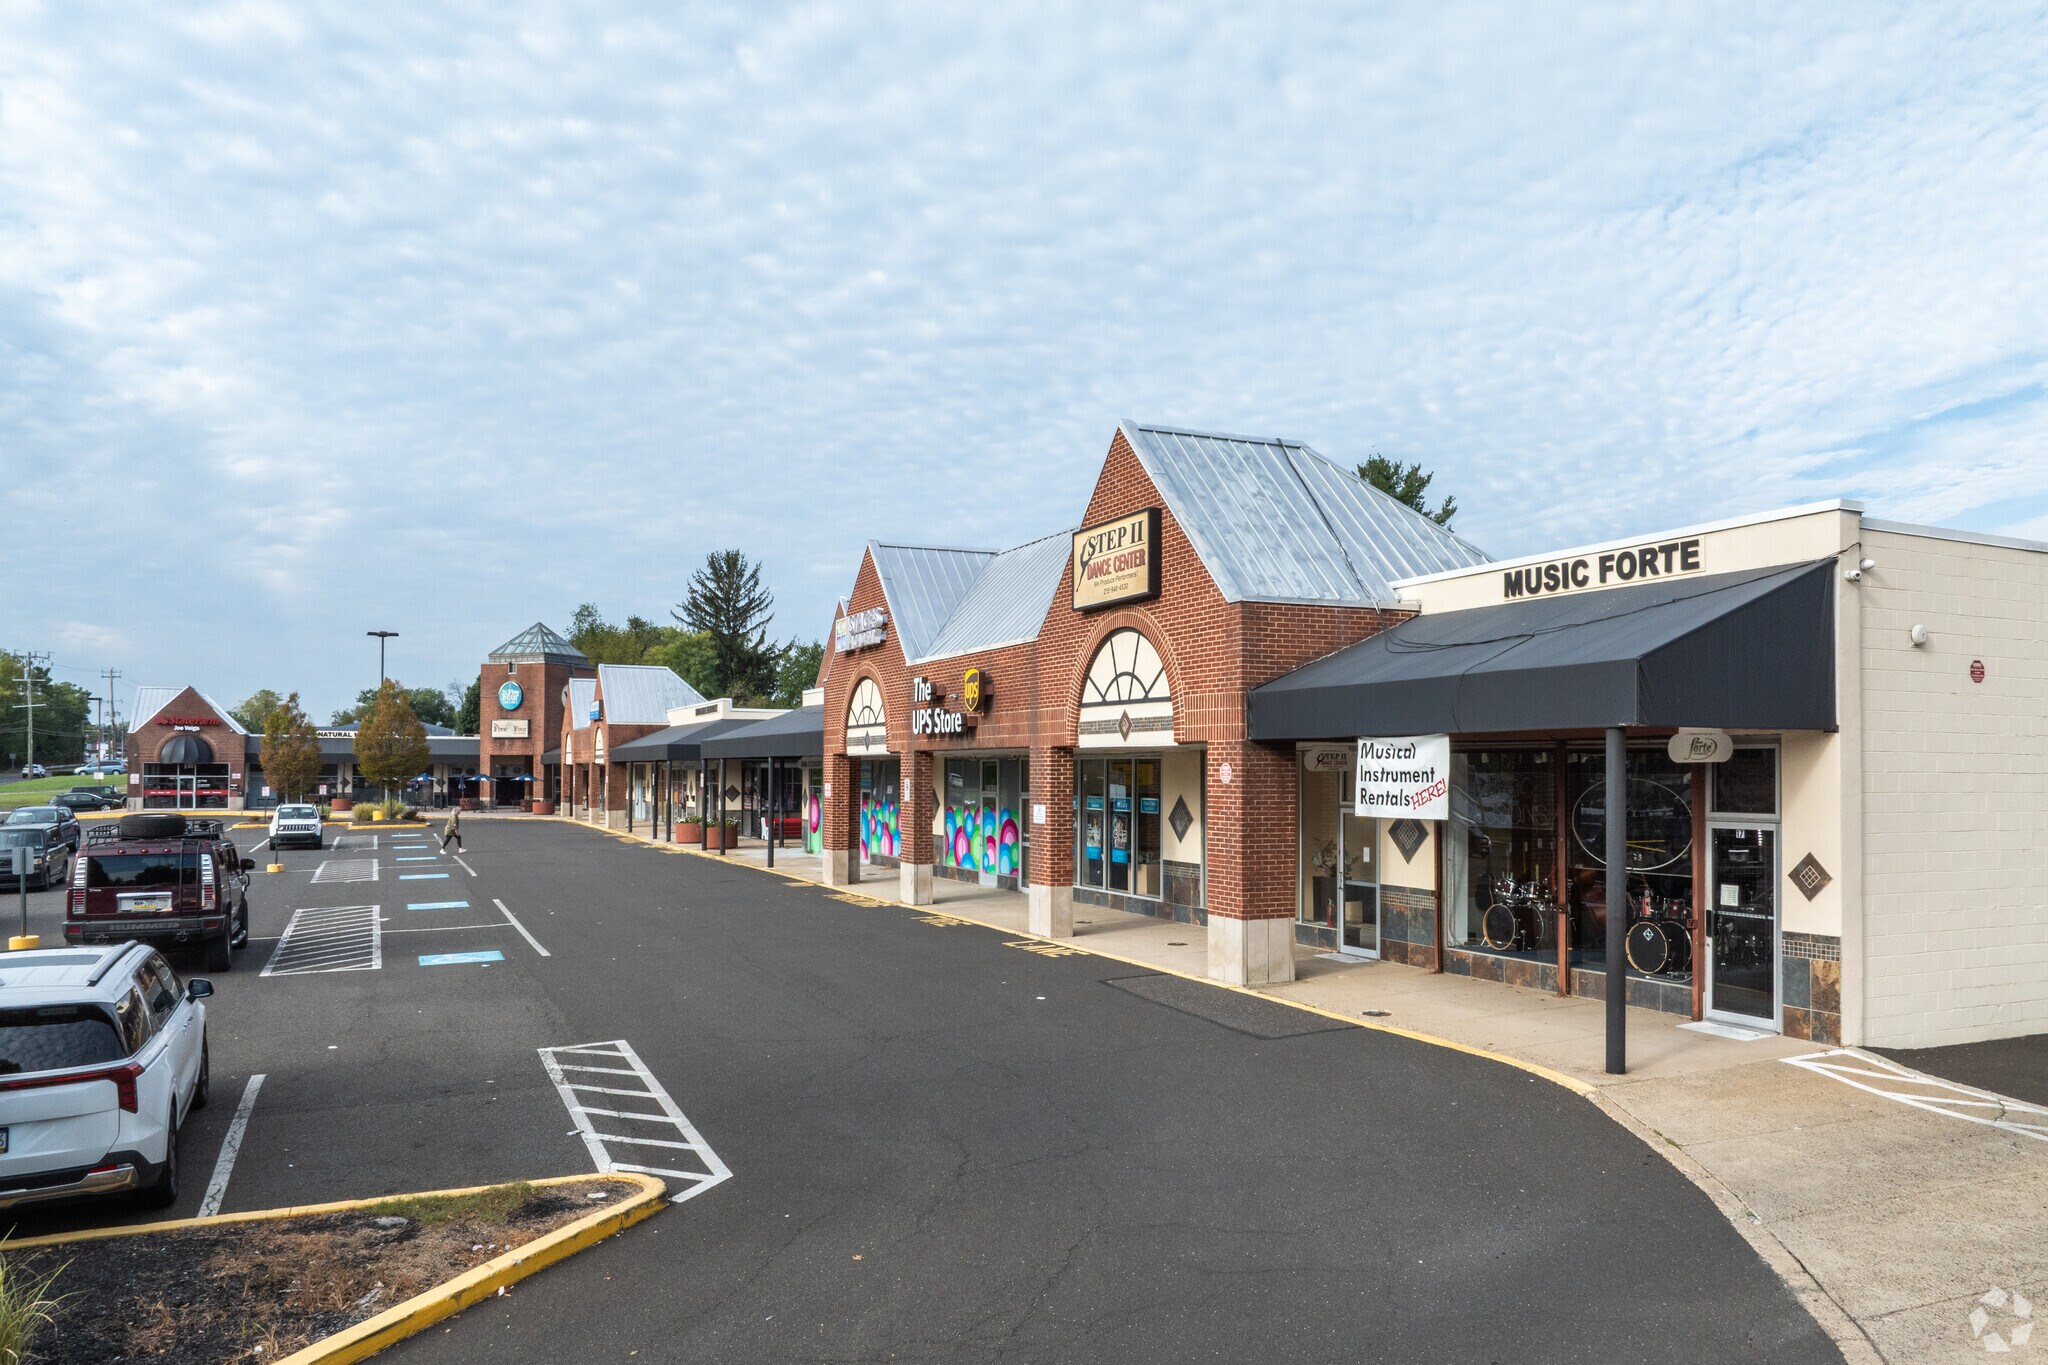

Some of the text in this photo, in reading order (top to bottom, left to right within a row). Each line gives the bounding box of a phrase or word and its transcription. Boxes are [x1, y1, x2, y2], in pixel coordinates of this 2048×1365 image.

[1087, 520, 1144, 556] STEP II
[1087, 548, 1146, 580] DANCE CENTER
[1504, 539, 1700, 598] MUSIC FORTE
[913, 677, 932, 702] The
[965, 682, 979, 705] ups
[912, 707, 962, 735] UPS Store
[1361, 742, 1416, 760] Musical
[1360, 764, 1435, 783] Instrument
[1360, 787, 1411, 807] Rentals
[1410, 778, 1447, 810] HERE!
[109, 921, 180, 931] HUMMER
